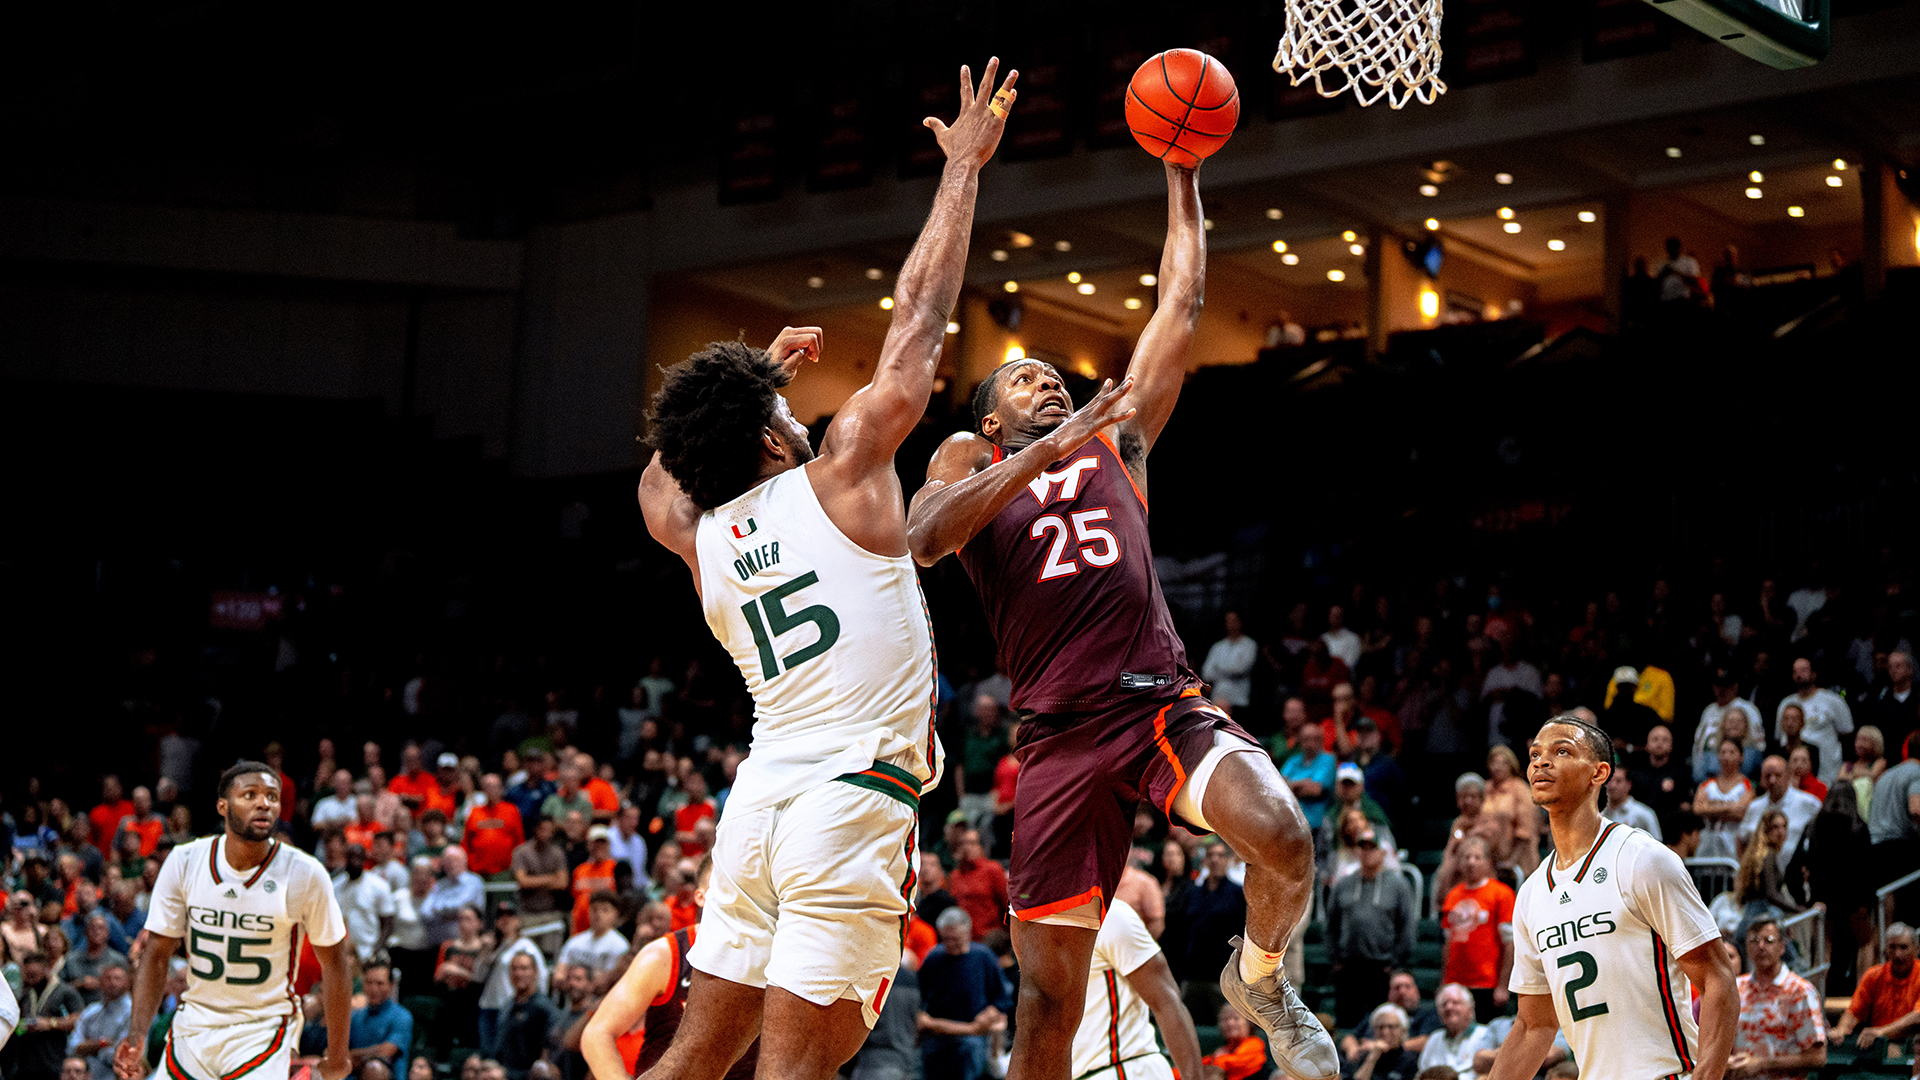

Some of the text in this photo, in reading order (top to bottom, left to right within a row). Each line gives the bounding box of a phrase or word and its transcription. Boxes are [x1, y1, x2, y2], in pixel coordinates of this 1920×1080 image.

[731, 517, 758, 539] U
[734, 541, 780, 581] OMIER
[1029, 506, 1121, 583] 25
[740, 570, 841, 682] 15
[190, 926, 272, 987] 55
[1557, 951, 1610, 1022] 2
